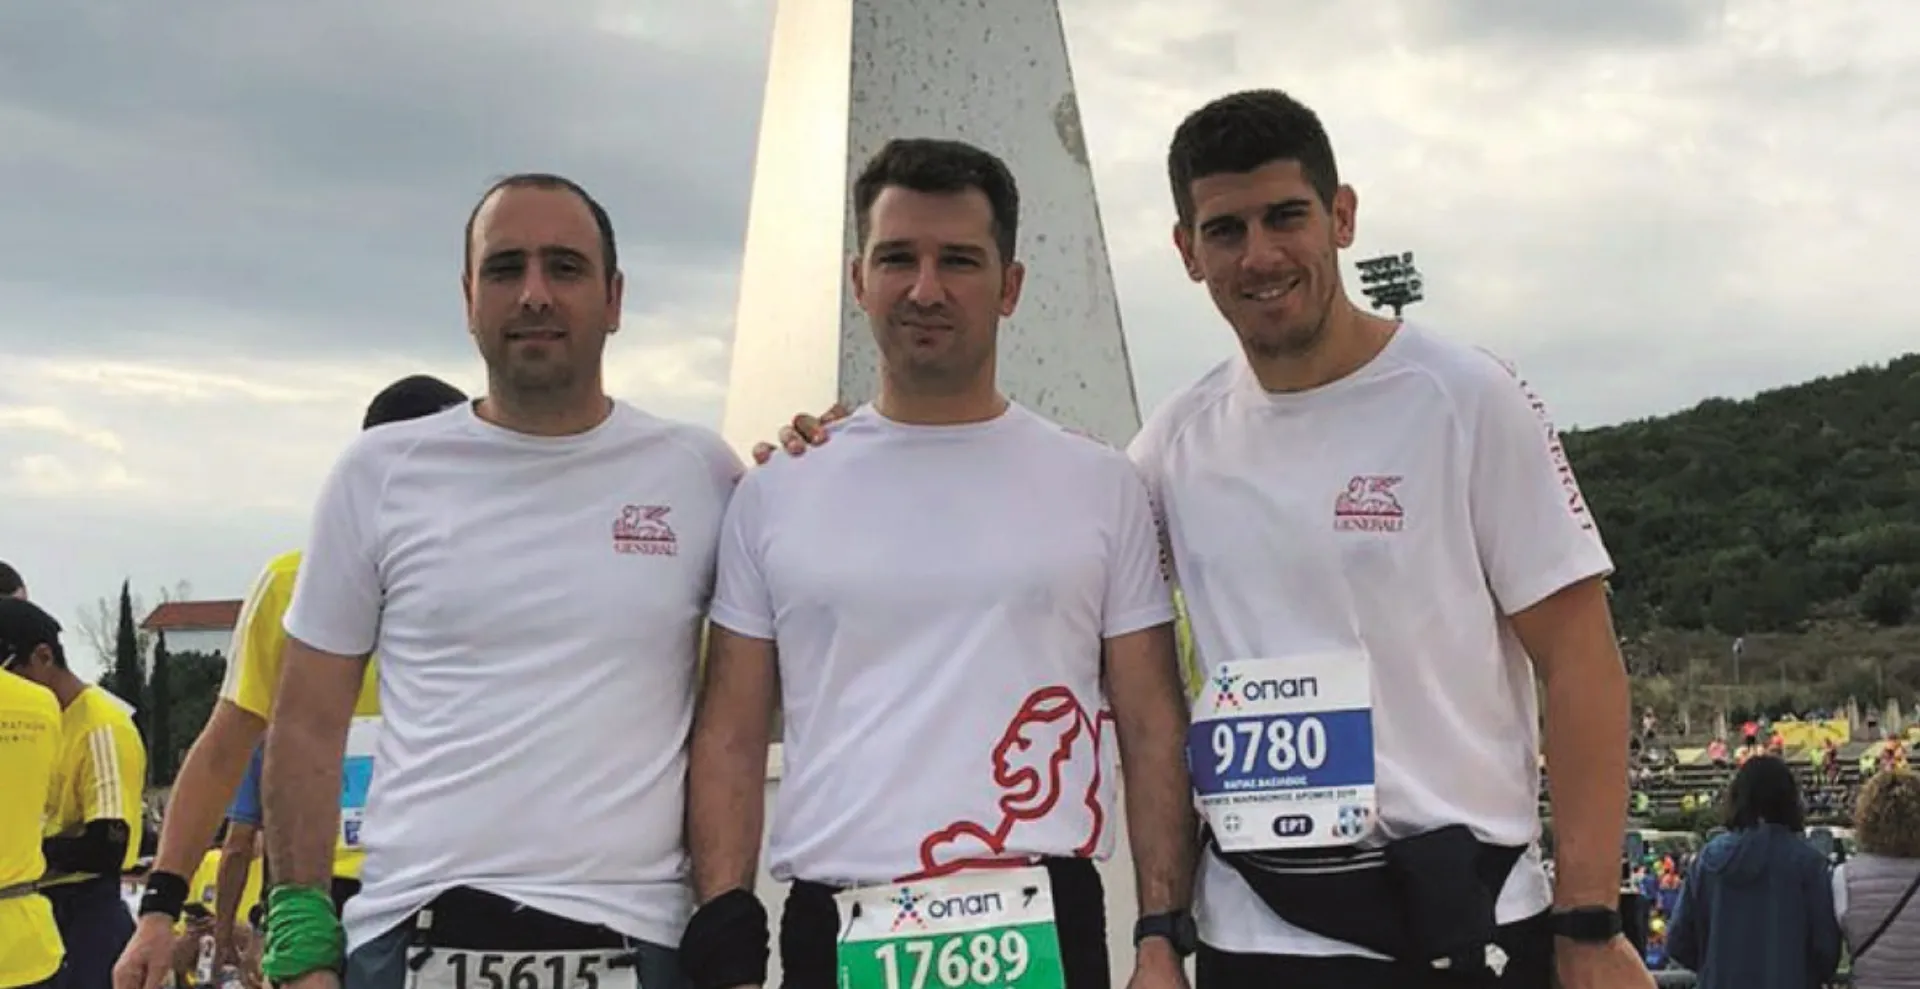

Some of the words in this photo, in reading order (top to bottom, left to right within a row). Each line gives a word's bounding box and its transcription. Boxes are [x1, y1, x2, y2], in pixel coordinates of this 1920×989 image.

[1333, 517, 1404, 533] GENERALI
[614, 543, 677, 555] GENERALI
[1212, 717, 1326, 774] 9780
[447, 953, 600, 989] 15615
[875, 930, 1028, 989] 17689
